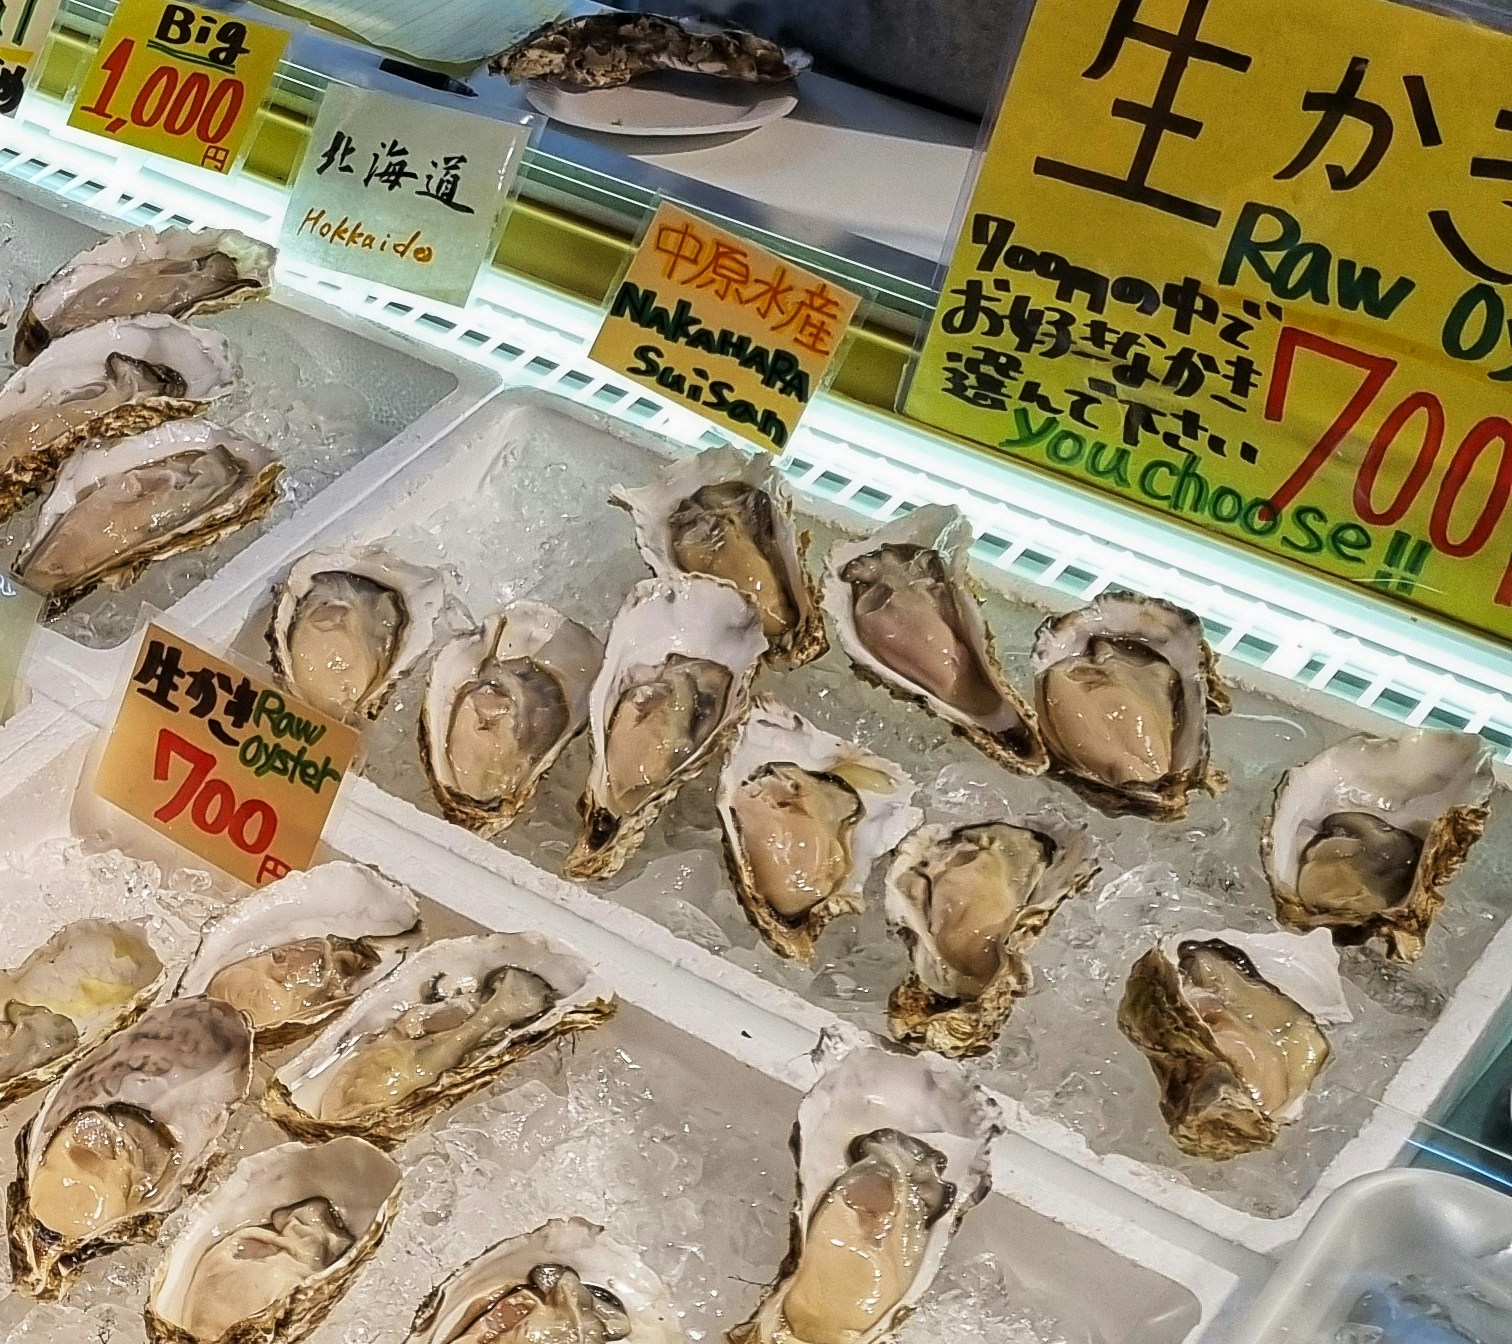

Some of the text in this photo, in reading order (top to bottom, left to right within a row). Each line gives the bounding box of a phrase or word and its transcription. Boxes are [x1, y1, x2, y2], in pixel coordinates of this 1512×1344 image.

[154, 4, 250, 65] Big
[315, 129, 476, 215] 北海道
[296, 205, 434, 265] Hokkaido
[1216, 200, 1418, 320] Raw
[653, 221, 832, 358] 中原水産
[1264, 325, 1512, 606] 700
[132, 639, 257, 747] 生かき
[252, 688, 328, 747] Raw
